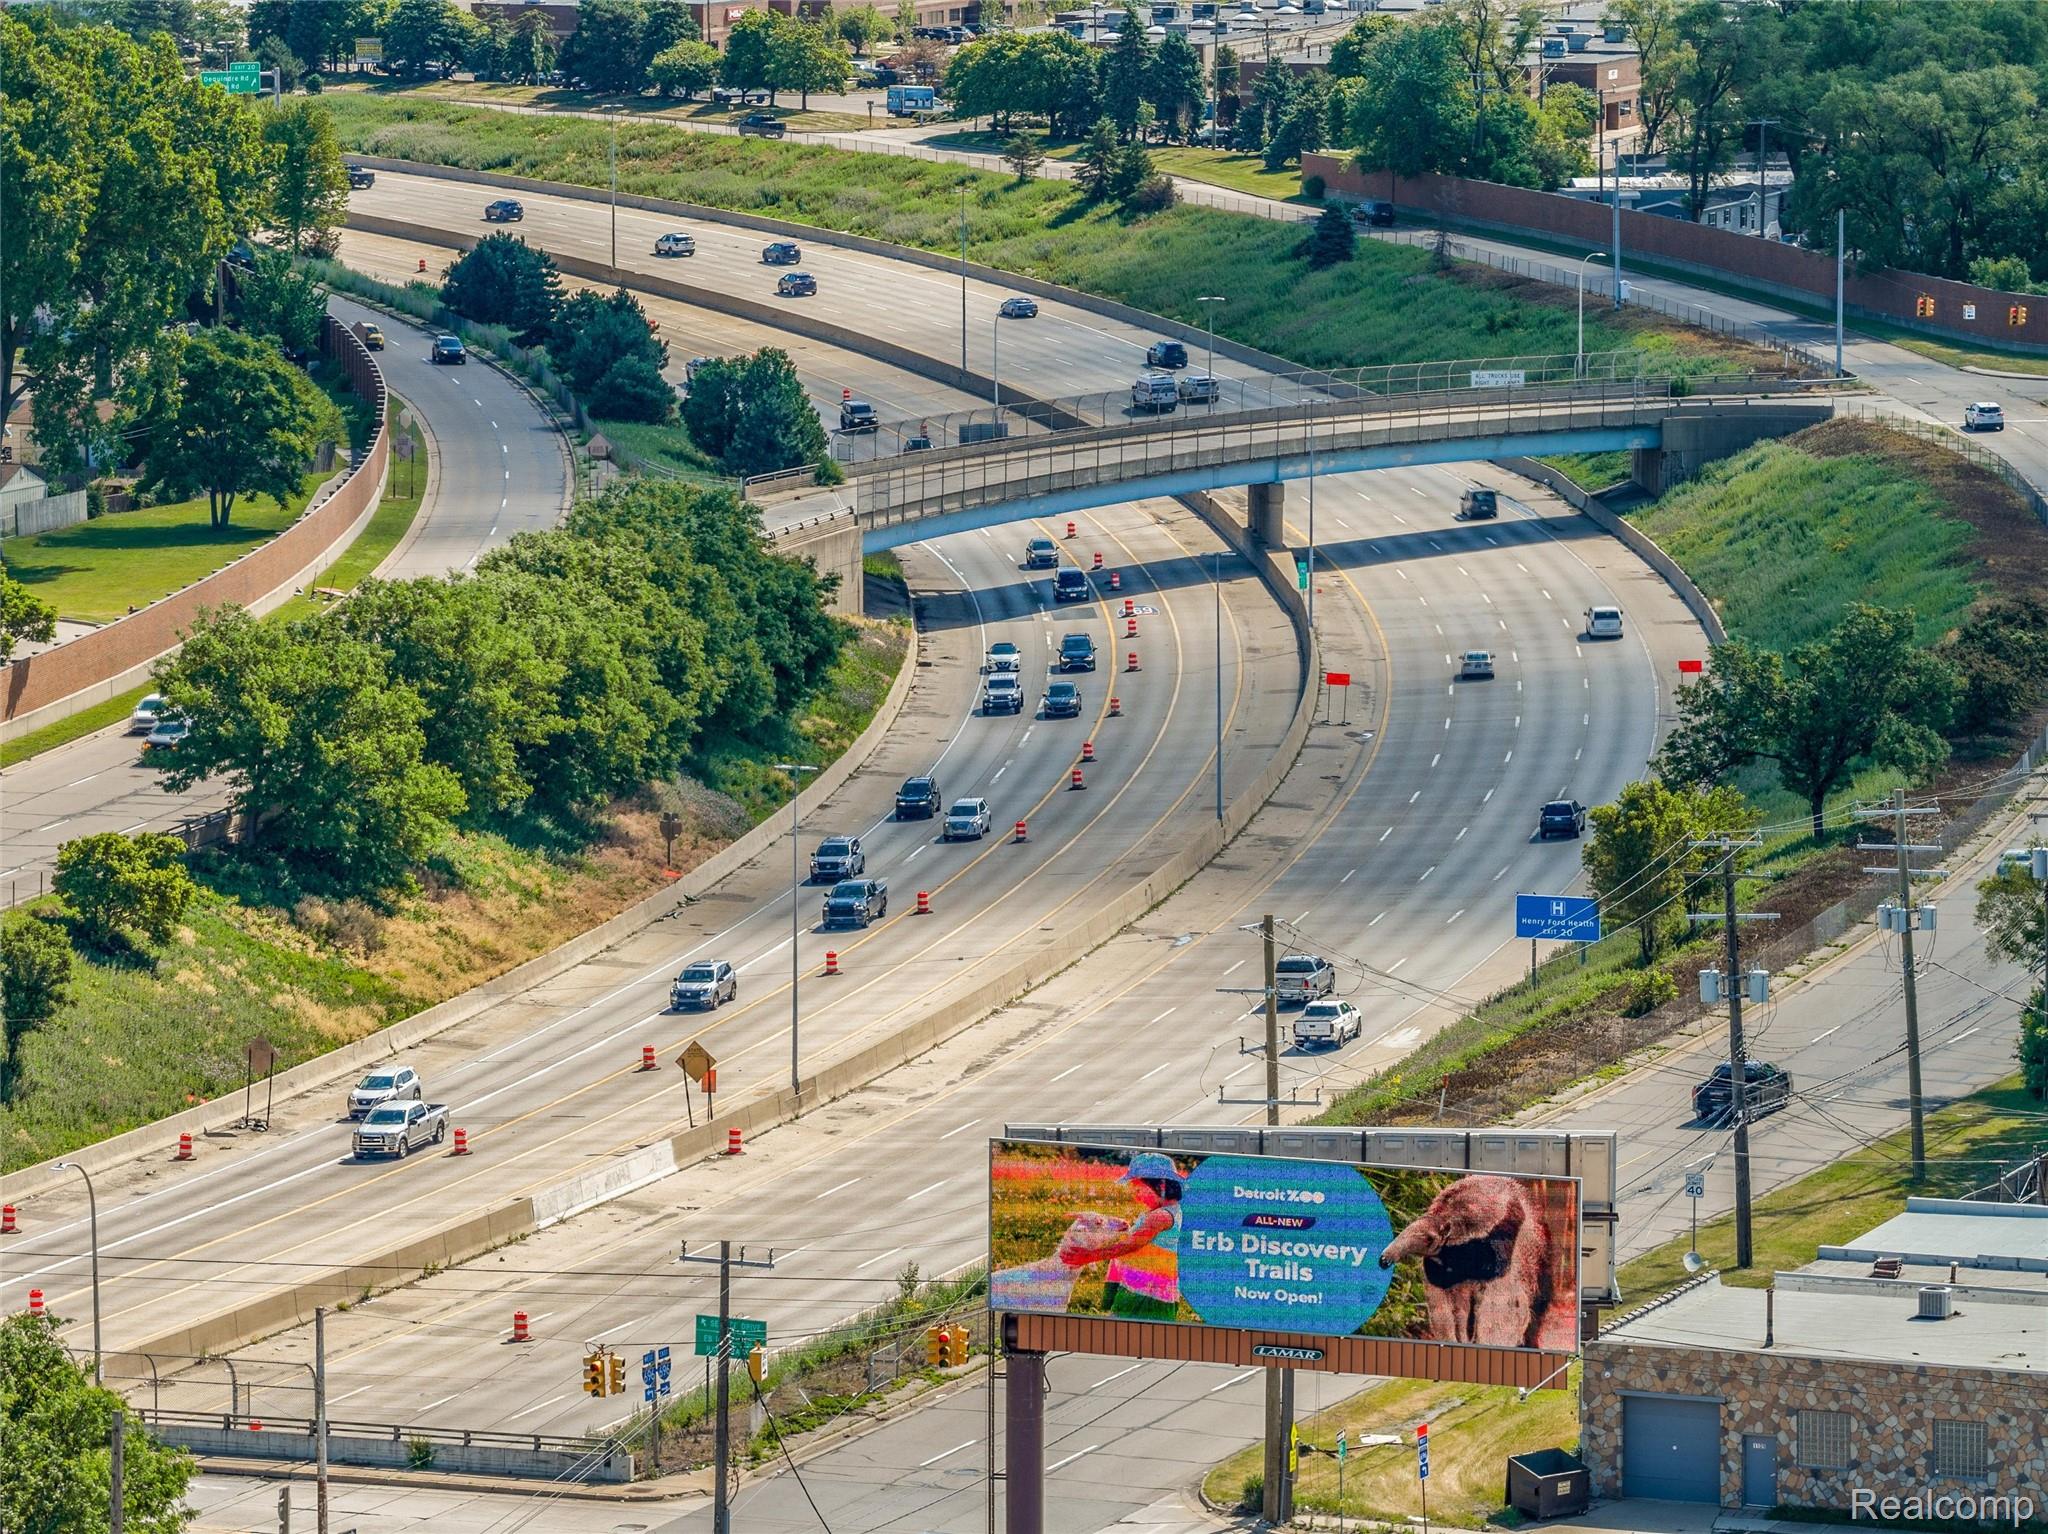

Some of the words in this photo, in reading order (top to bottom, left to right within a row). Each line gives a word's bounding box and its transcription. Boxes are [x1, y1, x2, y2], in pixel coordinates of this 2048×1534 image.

[1552, 901, 1564, 915] H
[1521, 917, 1545, 927] Henry
[1547, 918, 1566, 926] Ford
[1560, 928, 1573, 937] 20
[1233, 1186, 1286, 1201] Detroit
[1688, 1185, 1703, 1195] 40
[1255, 1216, 1304, 1227] ALL-NEW
[1191, 1230, 1235, 1252] Erb
[1241, 1233, 1368, 1267] Discovery
[1244, 1258, 1314, 1282] Trails
[1234, 1286, 1271, 1301] Now
[1274, 1289, 1323, 1305] Open!
[1259, 1347, 1317, 1359] LAMAR
